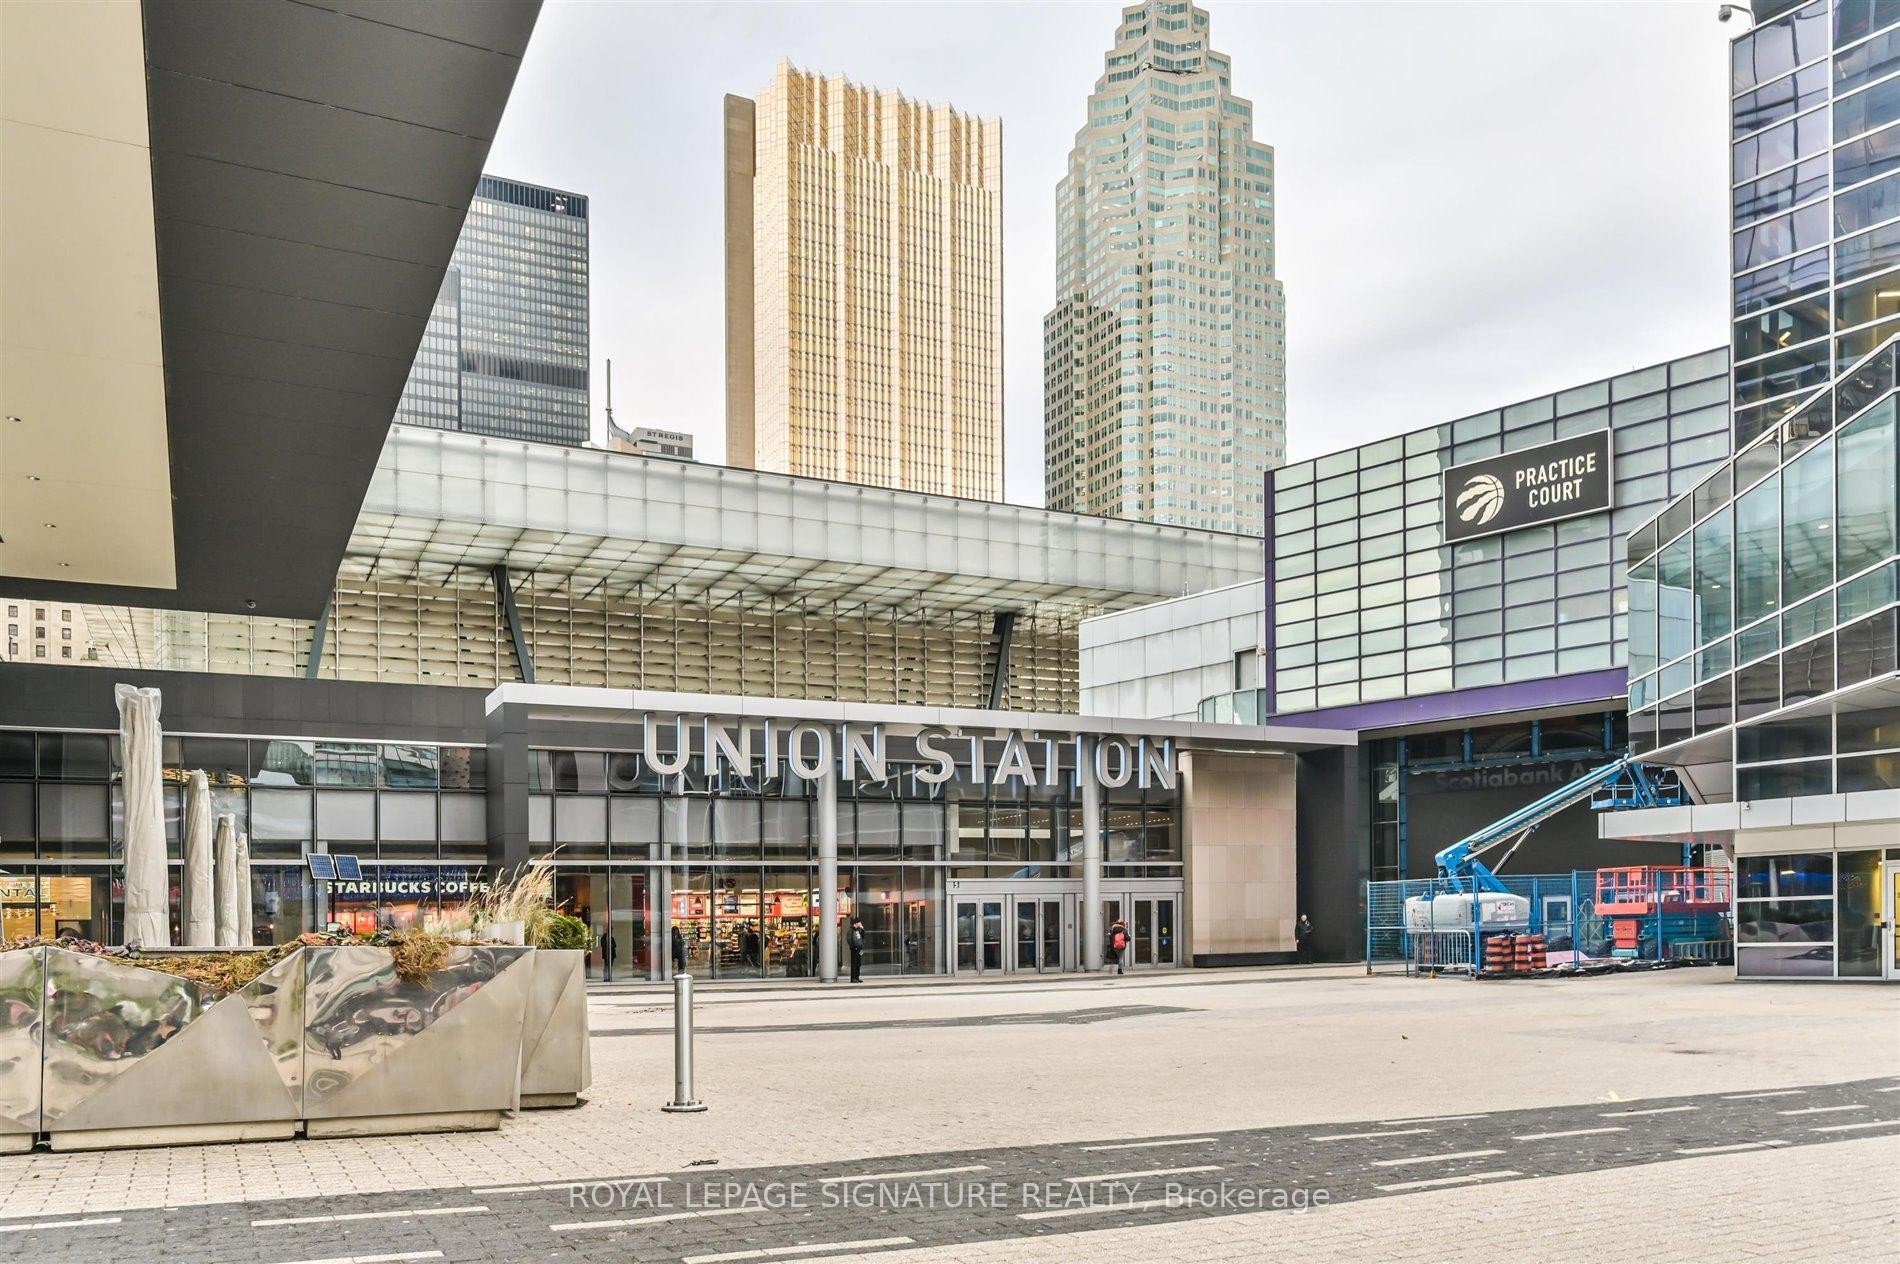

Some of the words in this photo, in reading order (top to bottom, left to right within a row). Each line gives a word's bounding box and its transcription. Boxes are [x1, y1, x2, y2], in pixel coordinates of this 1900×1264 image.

[658, 432, 684, 441] REGIS
[1515, 452, 1596, 490] PRACTICE
[1528, 478, 1583, 508] COURT
[643, 712, 887, 780] UNION
[915, 724, 1177, 790] STATION
[1435, 763, 1564, 792] Scotiabank
[326, 881, 431, 894] STARBUCKS
[434, 881, 490, 894] COFFE
